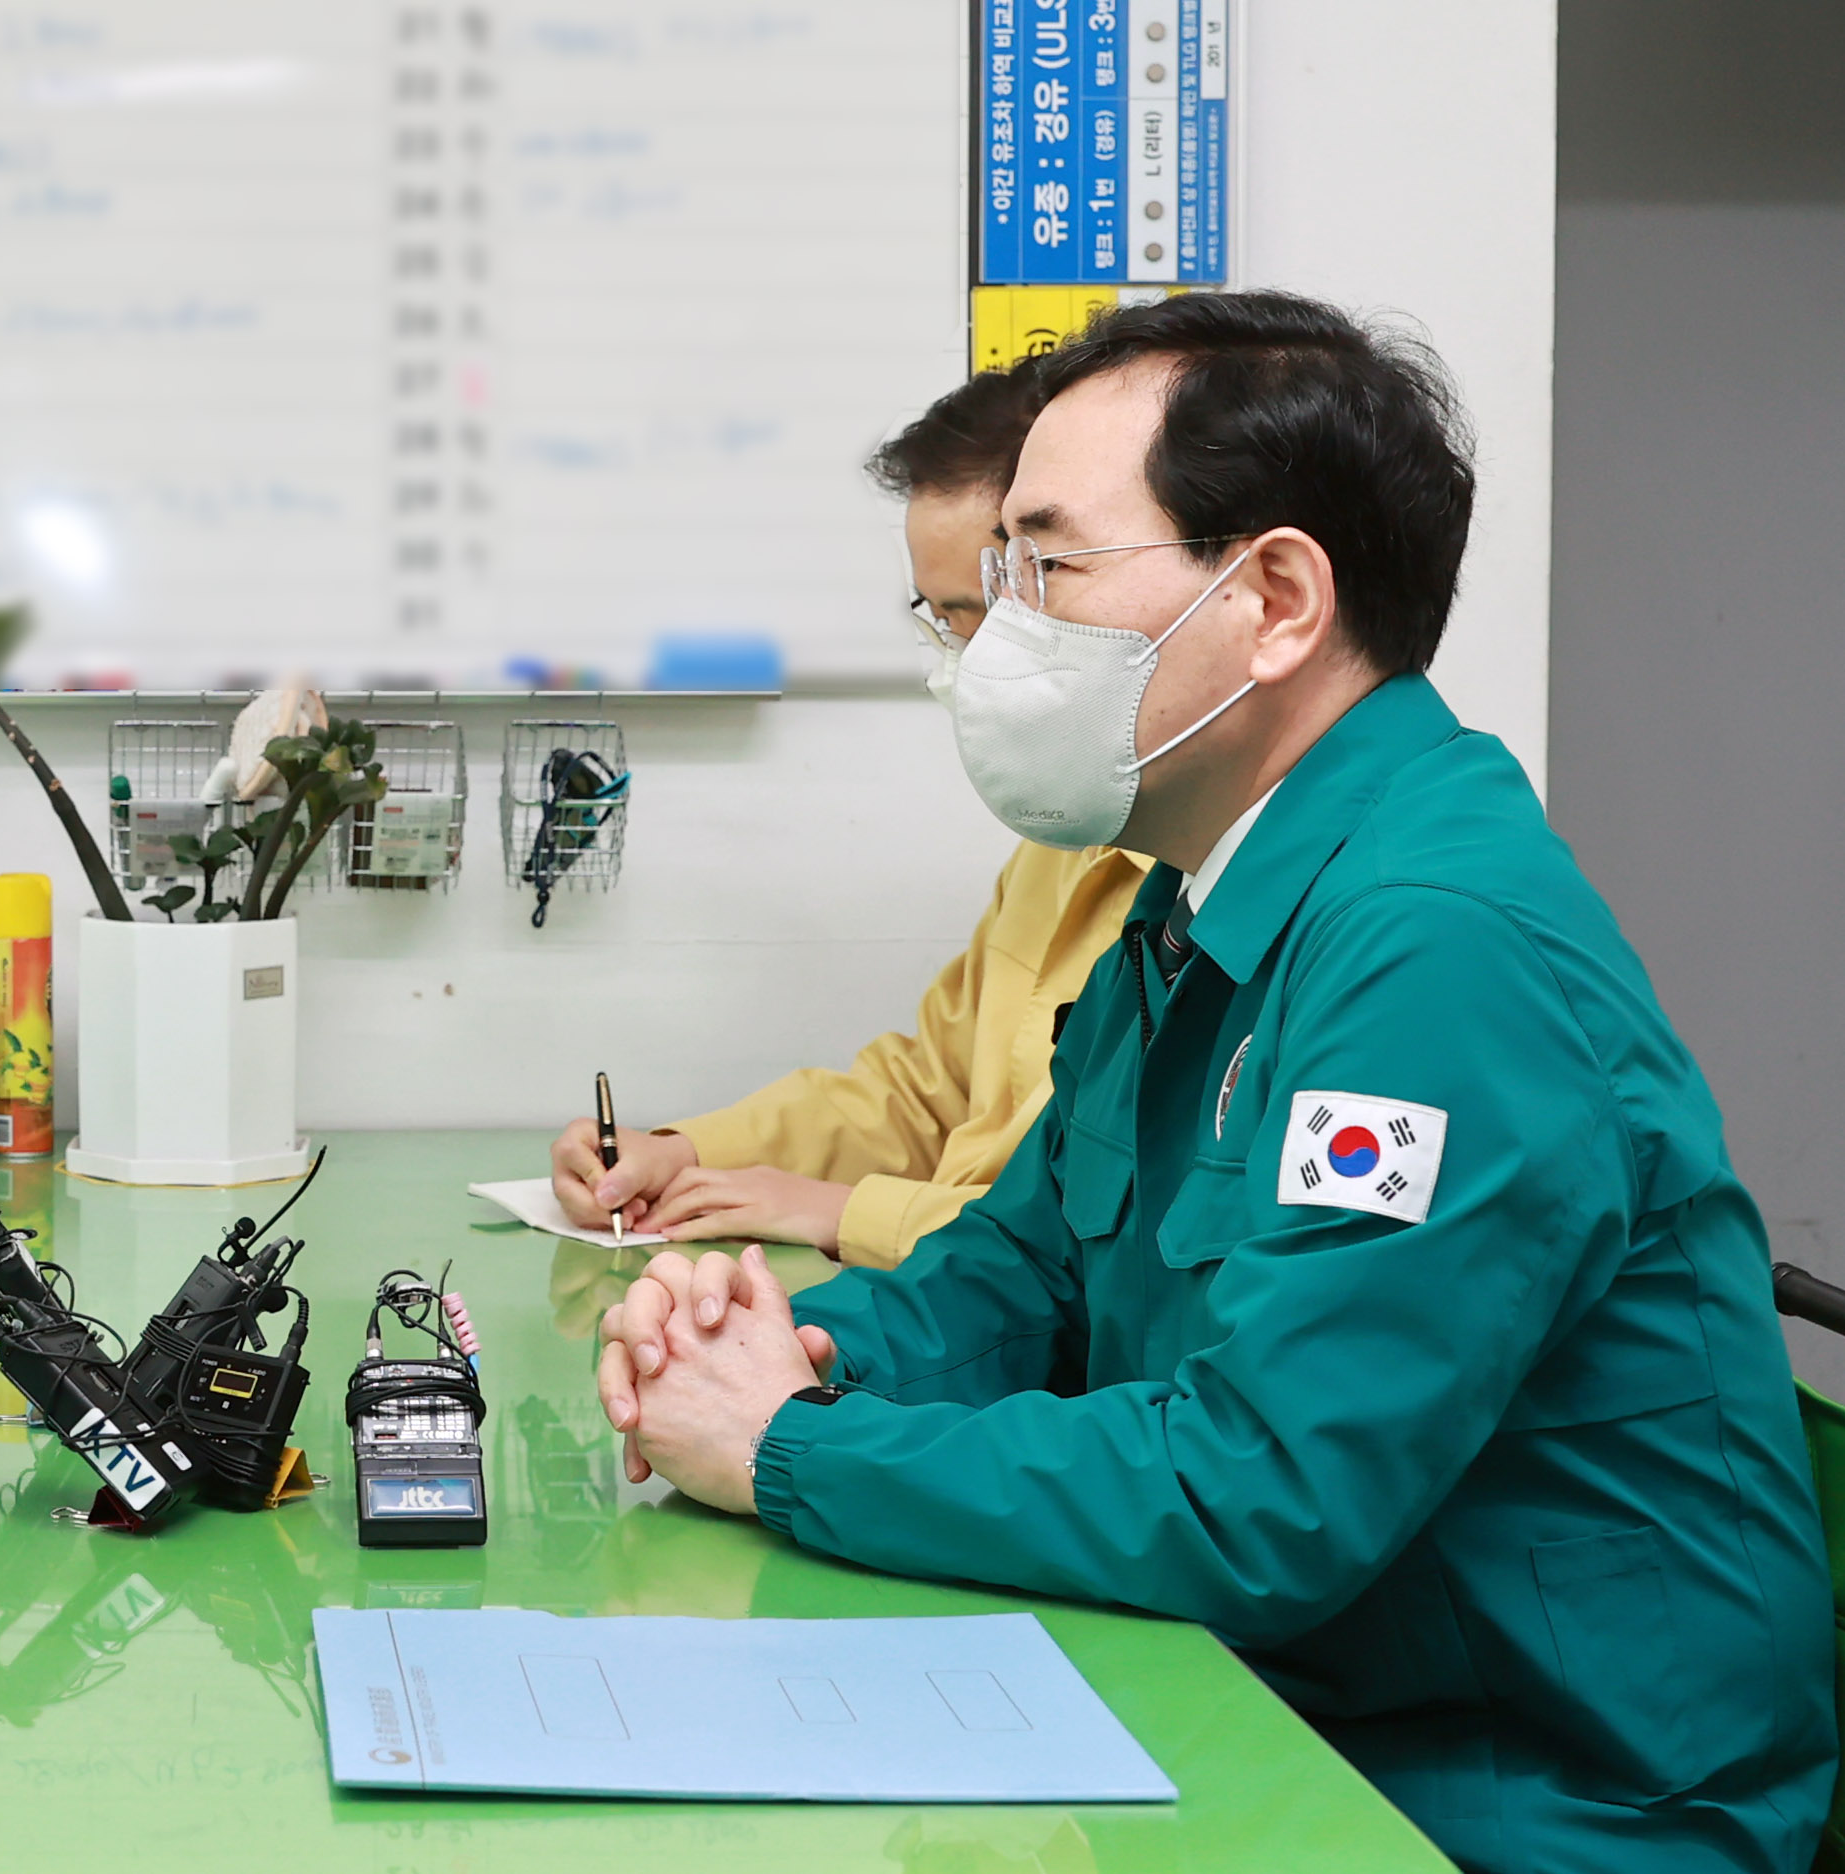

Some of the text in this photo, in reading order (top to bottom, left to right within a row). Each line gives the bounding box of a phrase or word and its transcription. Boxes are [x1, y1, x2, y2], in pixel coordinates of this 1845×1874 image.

[993, 0, 1014, 47] 비교
[993, 54, 1014, 95] 하역
[1096, 51, 1114, 85] 탱크
[993, 101, 1014, 164] 유조차
[1034, 79, 1068, 143] 경유
[1094, 110, 1115, 160] (경유)
[1144, 111, 1163, 159] (리터)
[1034, 181, 1068, 248] 유종
[1089, 179, 1114, 212] 1번
[1096, 233, 1114, 268] 탱크
[398, 1485, 446, 1508] jtbc
